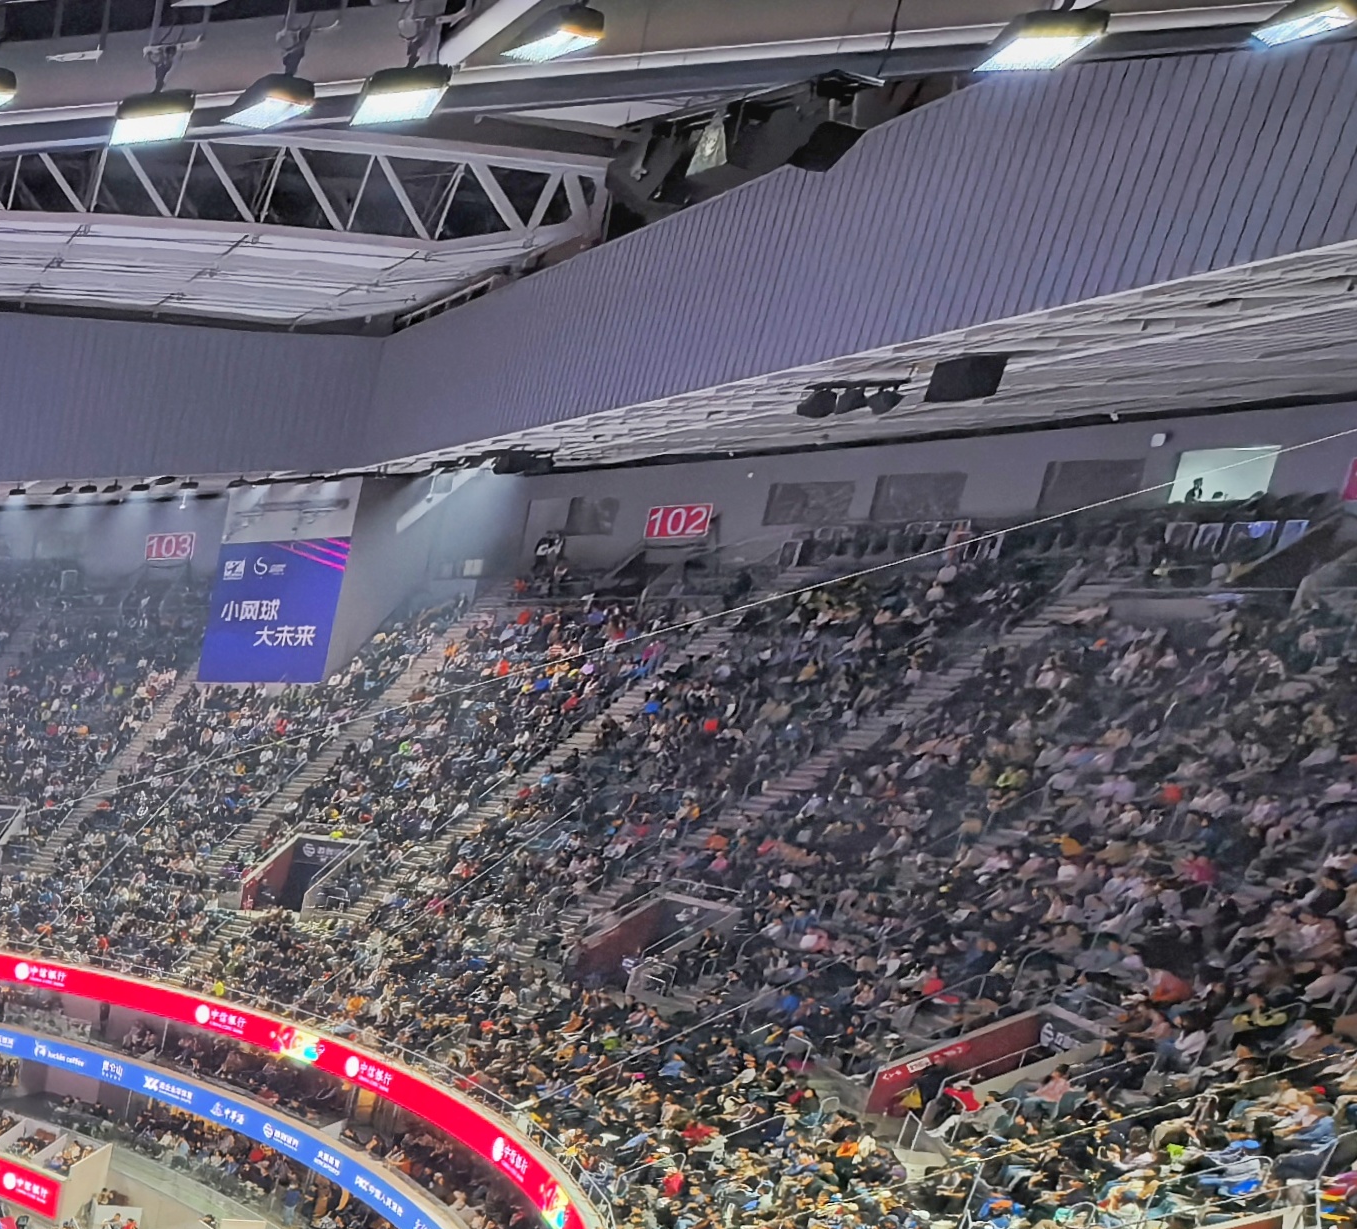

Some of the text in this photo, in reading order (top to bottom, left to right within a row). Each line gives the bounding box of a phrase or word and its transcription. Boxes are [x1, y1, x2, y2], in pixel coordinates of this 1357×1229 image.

[650, 507, 707, 536] 102
[147, 535, 193, 559] 103
[221, 599, 281, 621] 小网球
[253, 626, 316, 647] 大未来
[66, 1055, 85, 1067] coffee
